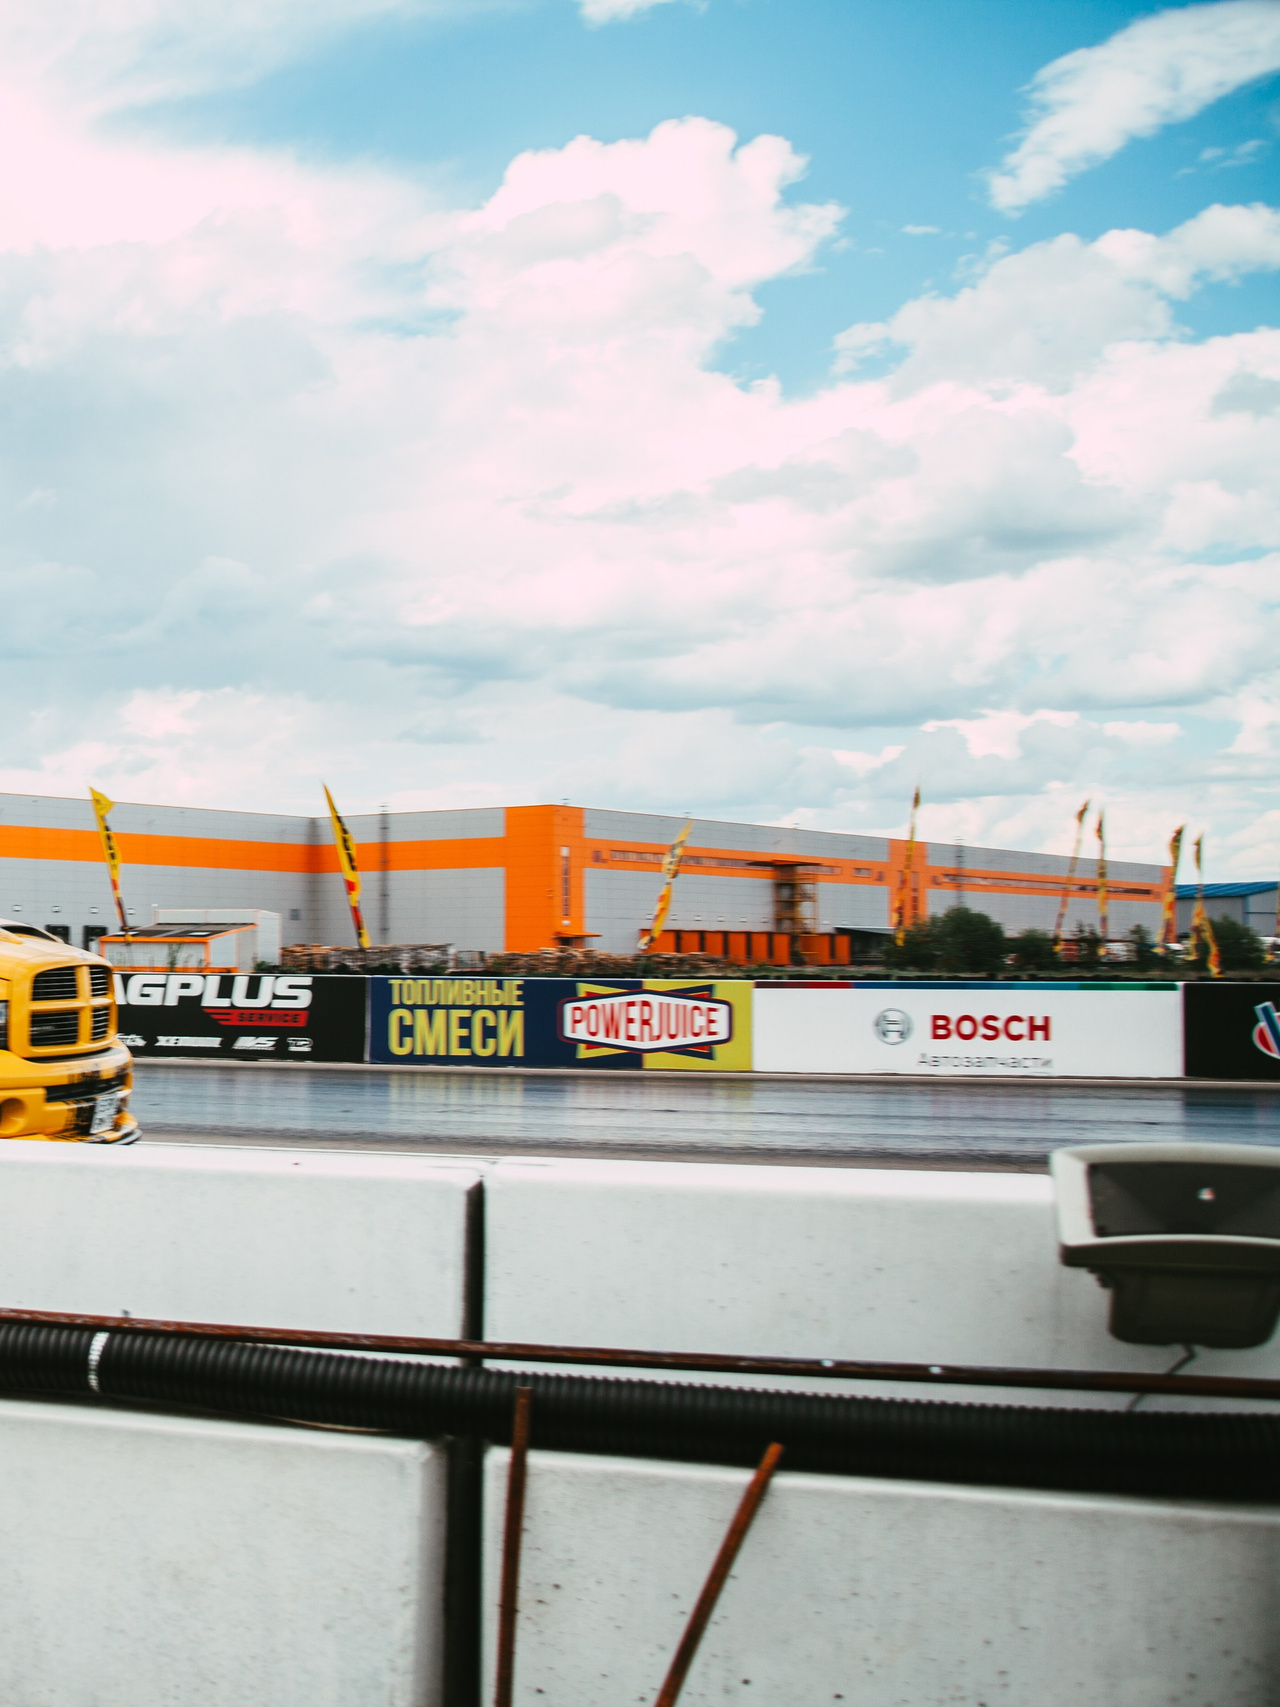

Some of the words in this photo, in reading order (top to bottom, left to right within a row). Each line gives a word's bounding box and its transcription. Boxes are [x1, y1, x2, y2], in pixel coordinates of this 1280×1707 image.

[388, 979, 524, 1006] ТОПЛИВНЫЕ
[238, 1012, 301, 1023] SERVICE
[570, 1000, 719, 1042] POWERJUICE
[931, 1014, 1052, 1041] BOSCH
[388, 1008, 524, 1057] СМЕСИ
[918, 1053, 1053, 1068] Автозапчасти
